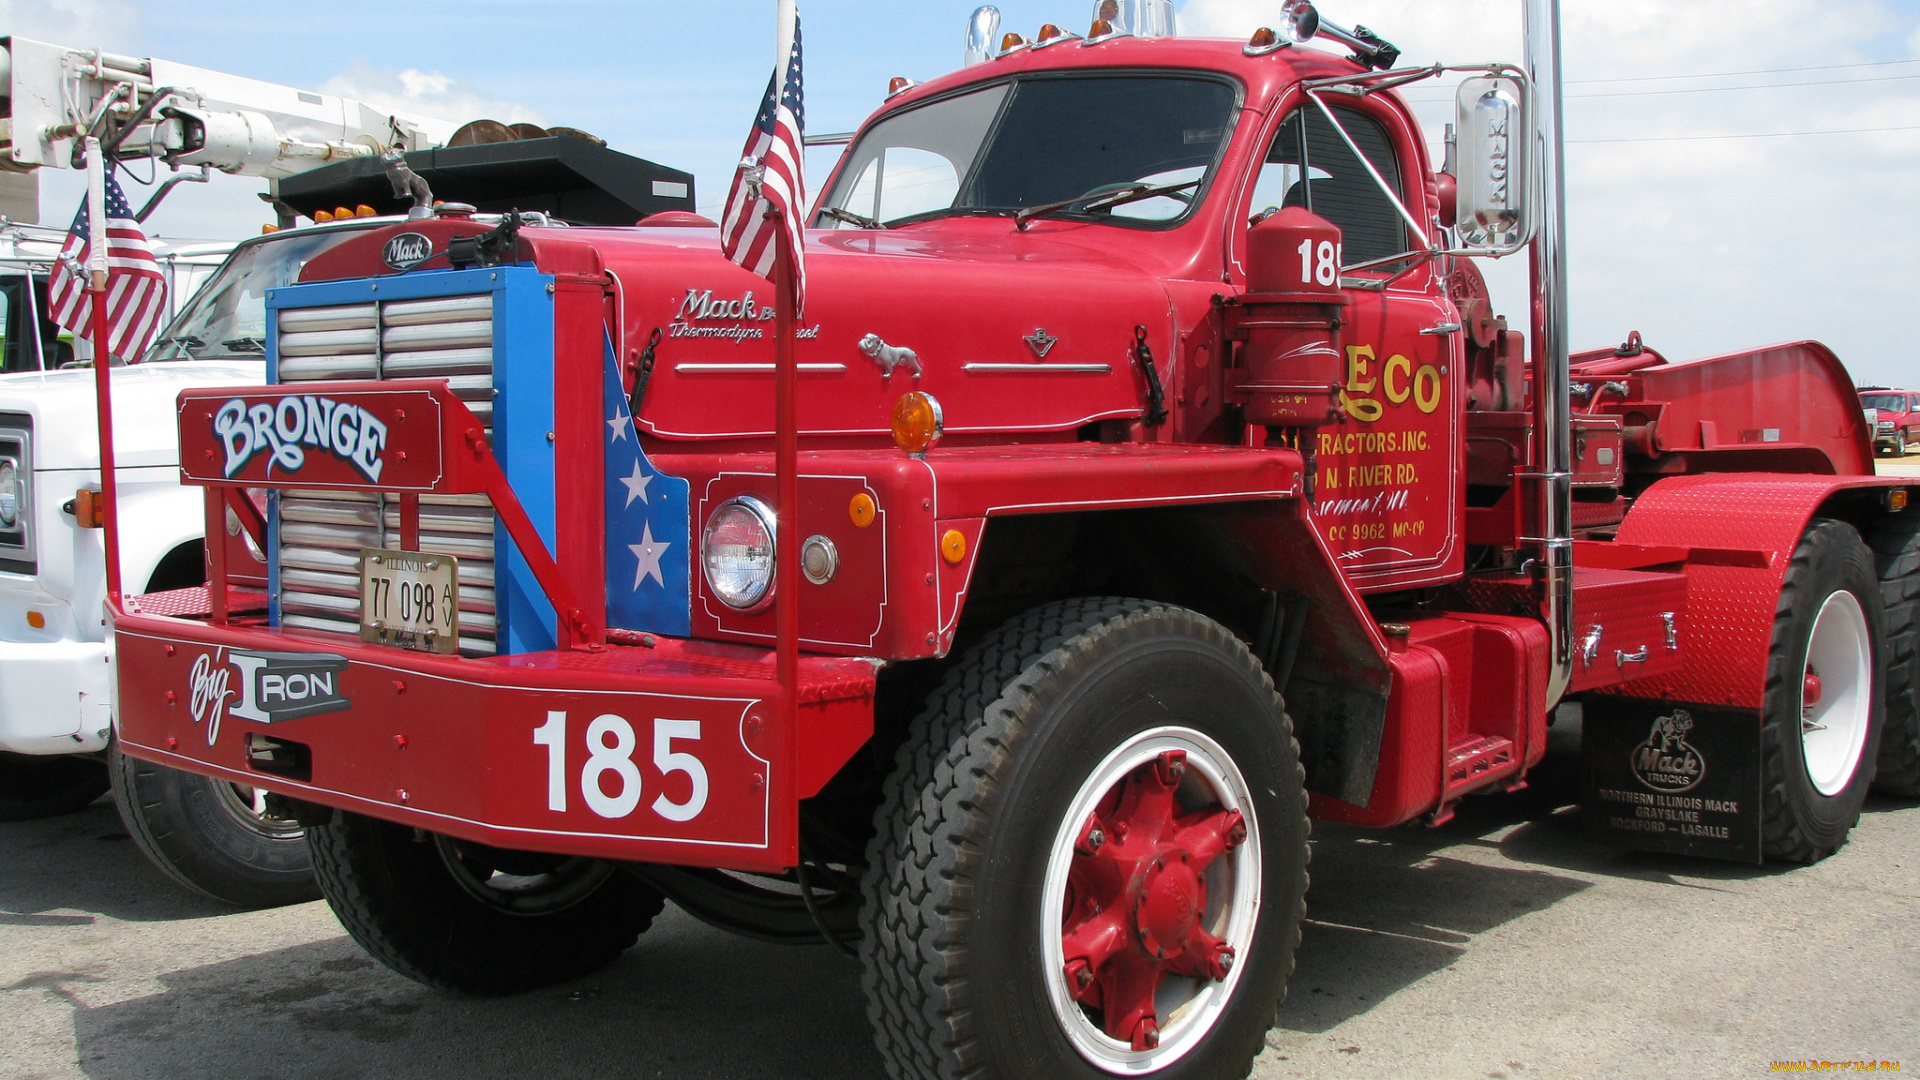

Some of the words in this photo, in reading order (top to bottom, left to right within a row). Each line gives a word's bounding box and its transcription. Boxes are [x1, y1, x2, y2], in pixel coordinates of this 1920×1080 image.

[1487, 118, 1508, 203] MACK
[386, 237, 425, 262] Mack
[674, 288, 758, 320] Mack
[668, 322, 763, 344] Thermodyne
[1339, 343, 1441, 422] ECO
[214, 395, 388, 484] BRONGE
[1348, 464, 1392, 488] RIVER
[1396, 463, 1419, 485] RD.
[1352, 523, 1386, 540] 9962
[386, 558, 429, 574] ILLINOIS
[371, 577, 392, 619] 77
[401, 581, 435, 625] 098
[189, 645, 236, 746] Big
[229, 653, 333, 725] IRON
[532, 710, 710, 823] 185
[1638, 747, 1699, 775] Mack
[1647, 773, 1690, 786] TRUCKS
[1600, 788, 1654, 806] NORTHERN
[1656, 794, 1702, 811] ILLINOIS
[1704, 799, 1738, 814] MACK
[1609, 816, 1666, 833] ROCKFORD
[1681, 824, 1729, 839] LASALLE
[1635, 806, 1699, 823] GRAYSLAKE
